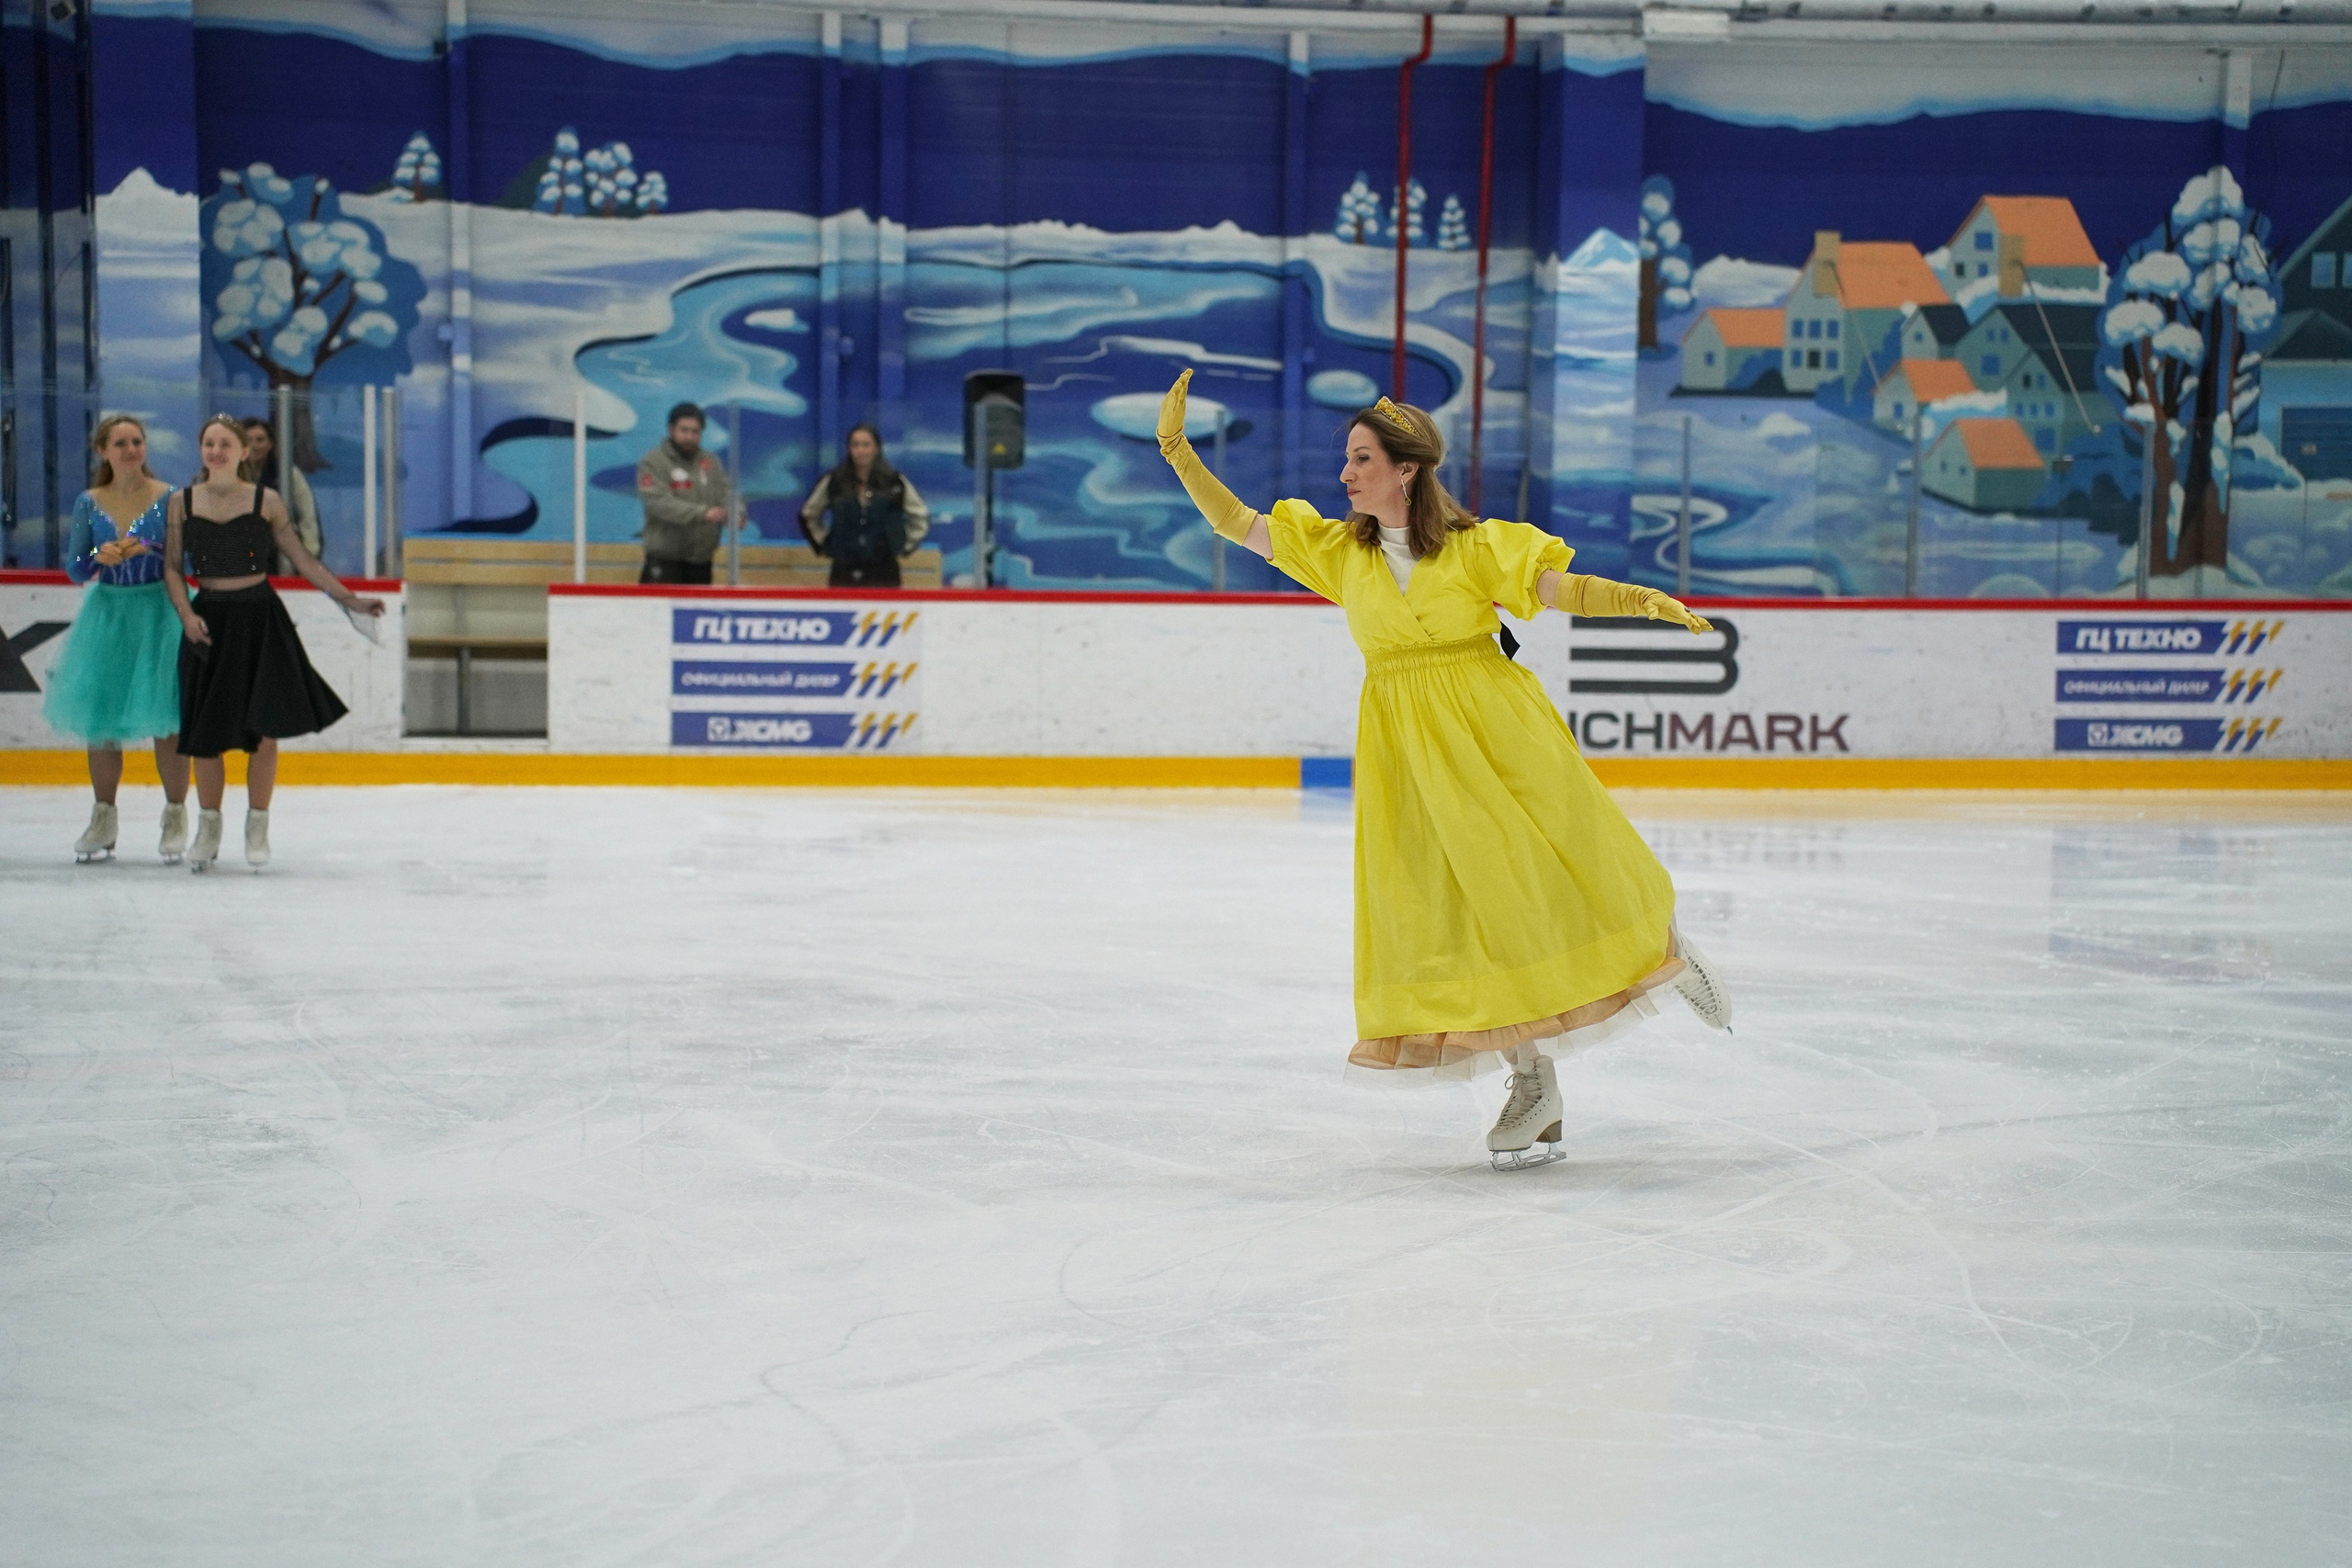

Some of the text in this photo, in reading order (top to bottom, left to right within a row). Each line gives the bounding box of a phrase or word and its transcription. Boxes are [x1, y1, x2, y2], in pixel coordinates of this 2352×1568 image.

[735, 616, 831, 641] ТЕХНО
[2114, 627, 2202, 650] ТЕХНО
[1568, 710, 1850, 752] CHMARK
